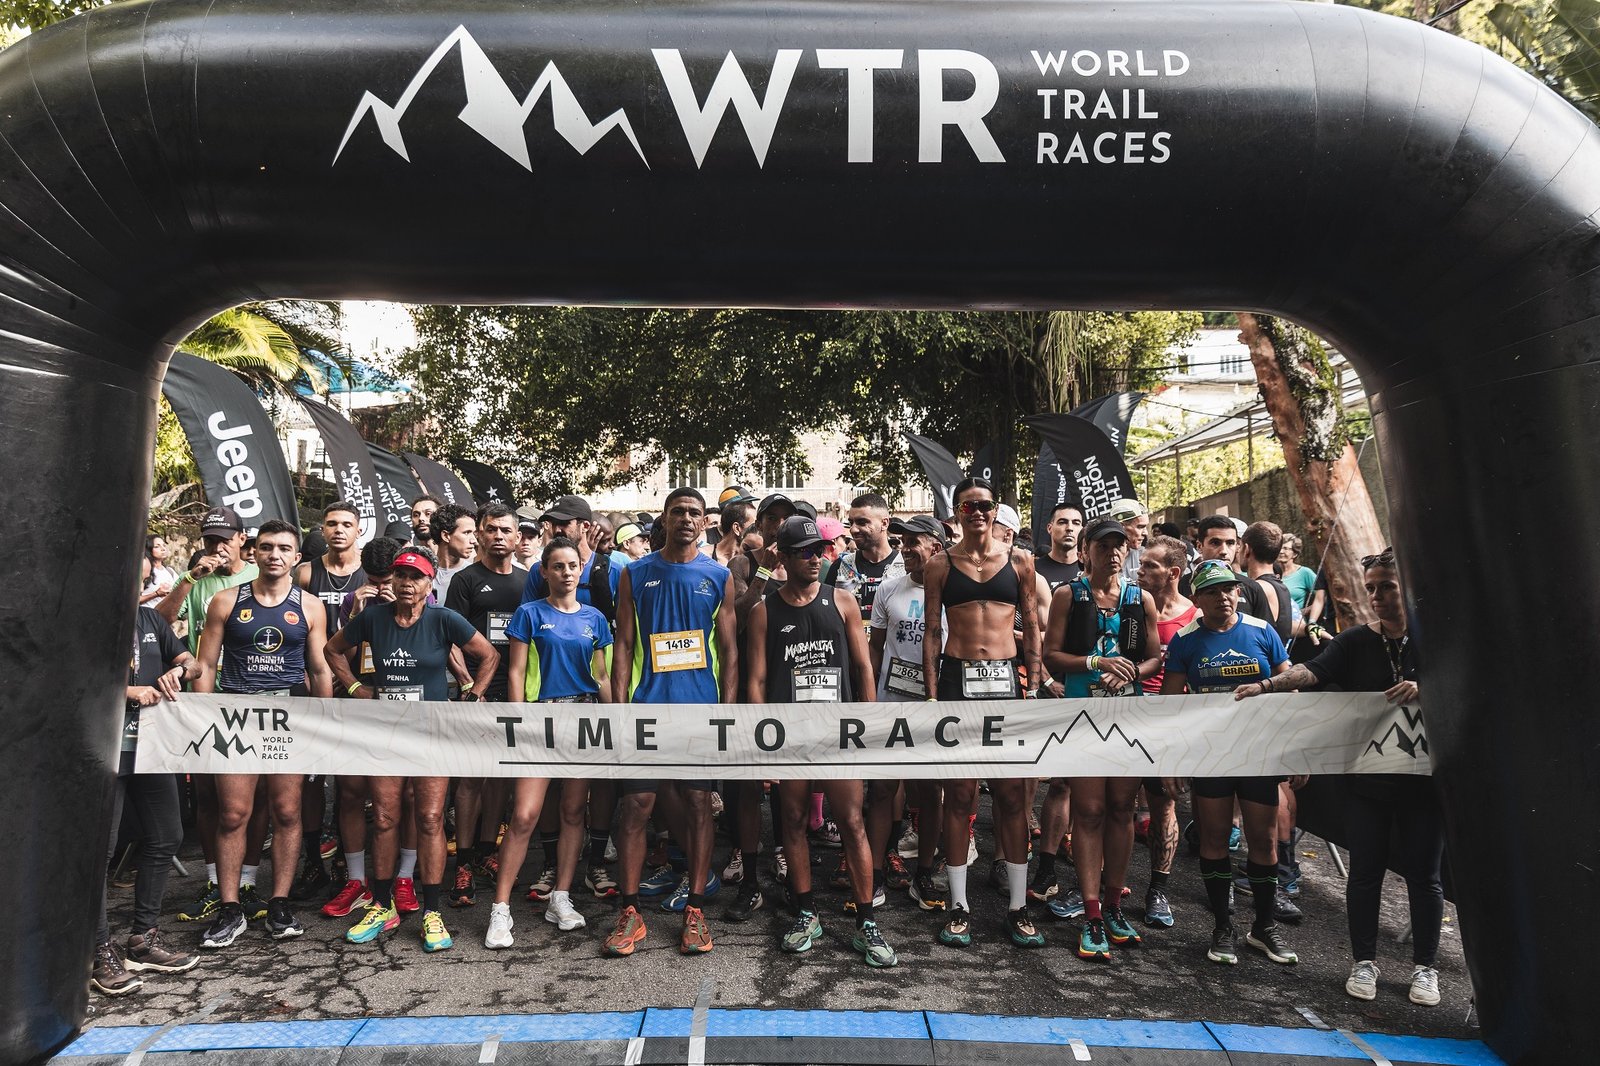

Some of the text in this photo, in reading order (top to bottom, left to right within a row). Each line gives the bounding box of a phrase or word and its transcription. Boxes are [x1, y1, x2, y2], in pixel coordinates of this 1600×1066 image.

[1030, 49, 1191, 77] WORLD
[651, 48, 1007, 170] WTR
[1036, 88, 1159, 120] TRAIL
[1036, 131, 1172, 164] RACES
[207, 410, 264, 519] Jeep
[342, 476, 357, 507] FAC
[348, 461, 367, 518] NORTH
[1076, 475, 1100, 520] FACE
[1083, 455, 1112, 517] NORTH
[1105, 475, 1123, 501] TH
[362, 485, 376, 517] THE
[665, 639, 691, 650] 1418
[247, 655, 285, 664] MARINHA
[258, 664, 286, 672] BRASIL
[382, 658, 405, 667] WTR
[1223, 665, 1258, 675] BRASIL
[386, 674, 410, 682] PENHA
[804, 674, 829, 685] 1014
[220, 707, 291, 732] WTR
[262, 736, 294, 744] WORLD
[496, 715, 1026, 751] TIME TO RACE.
[261, 752, 289, 760] RACES
[262, 744, 287, 752] TRAIL
